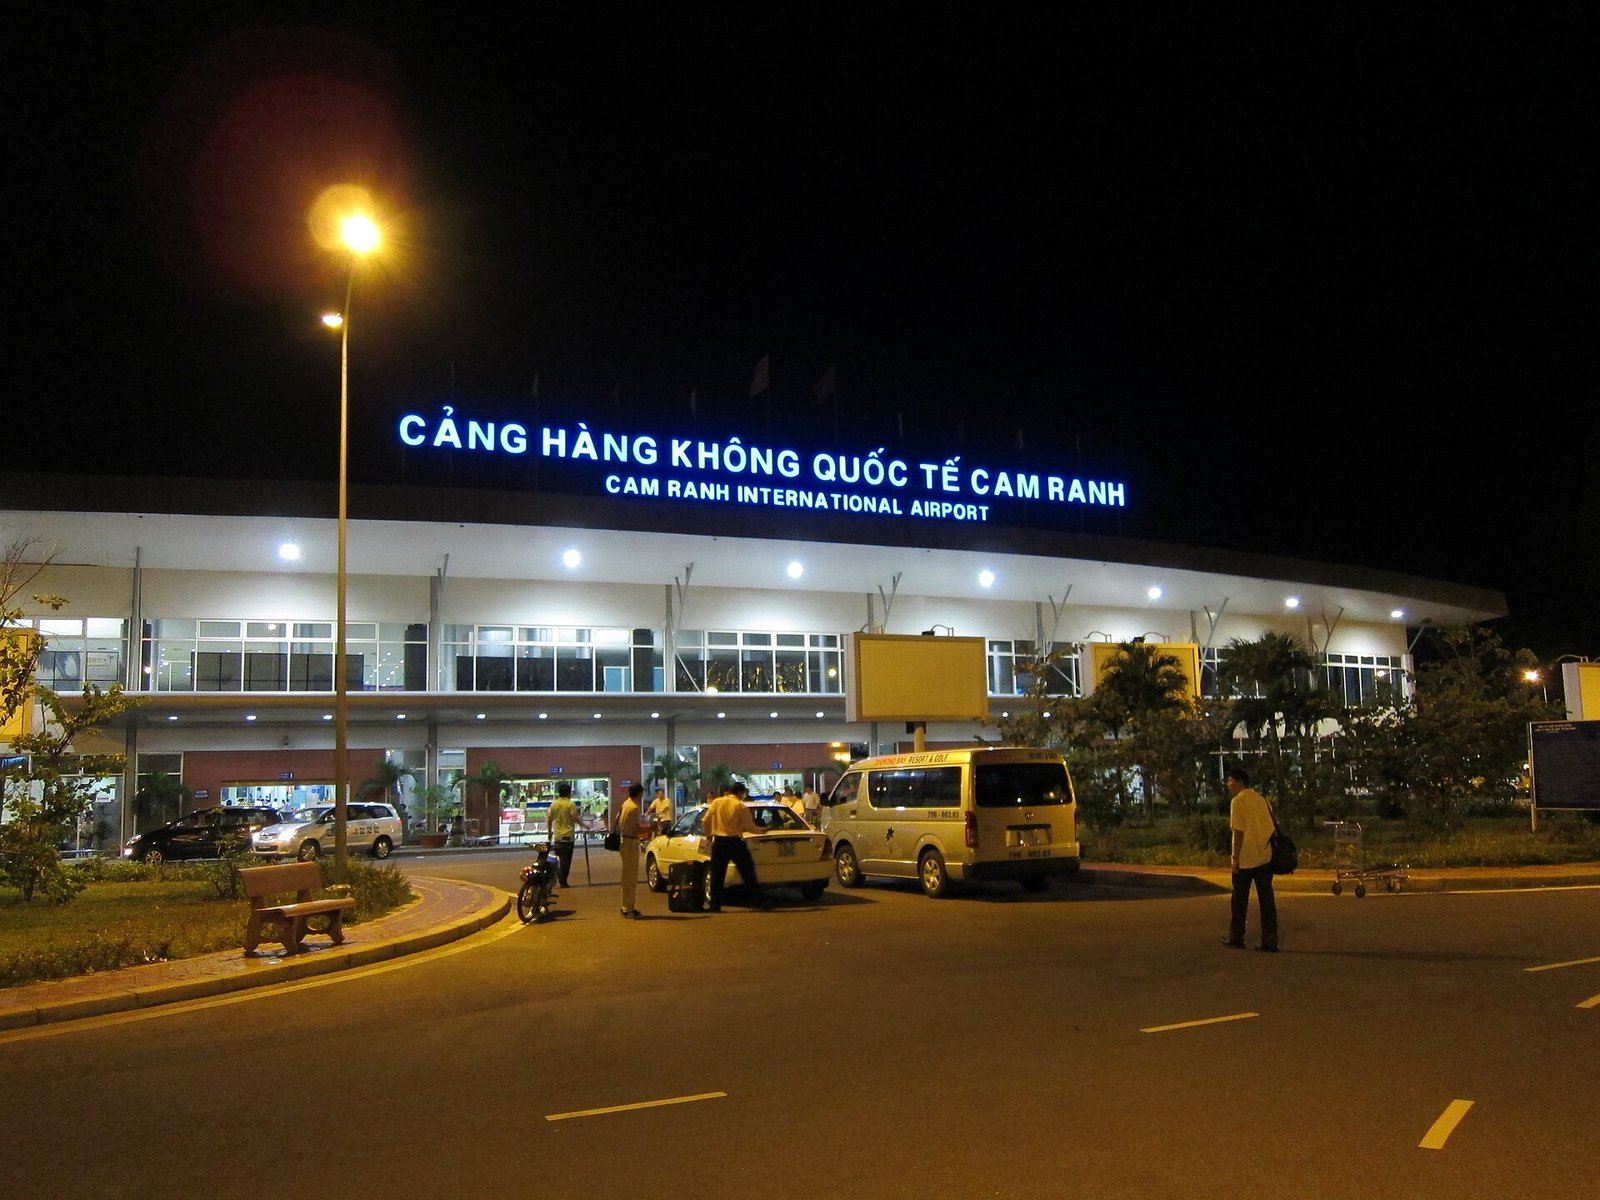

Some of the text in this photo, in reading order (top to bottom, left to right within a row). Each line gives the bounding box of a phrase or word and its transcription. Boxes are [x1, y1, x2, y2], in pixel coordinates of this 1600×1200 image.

[399, 405, 1125, 507] CẢNG HÀNG KHÔNG QUỐC TẾ CAM RANH
[605, 474, 989, 521] CAM RANH INTERNATIONAL AIRPORT
[908, 755, 928, 764] RESORT
[934, 753, 950, 763] GOLF
